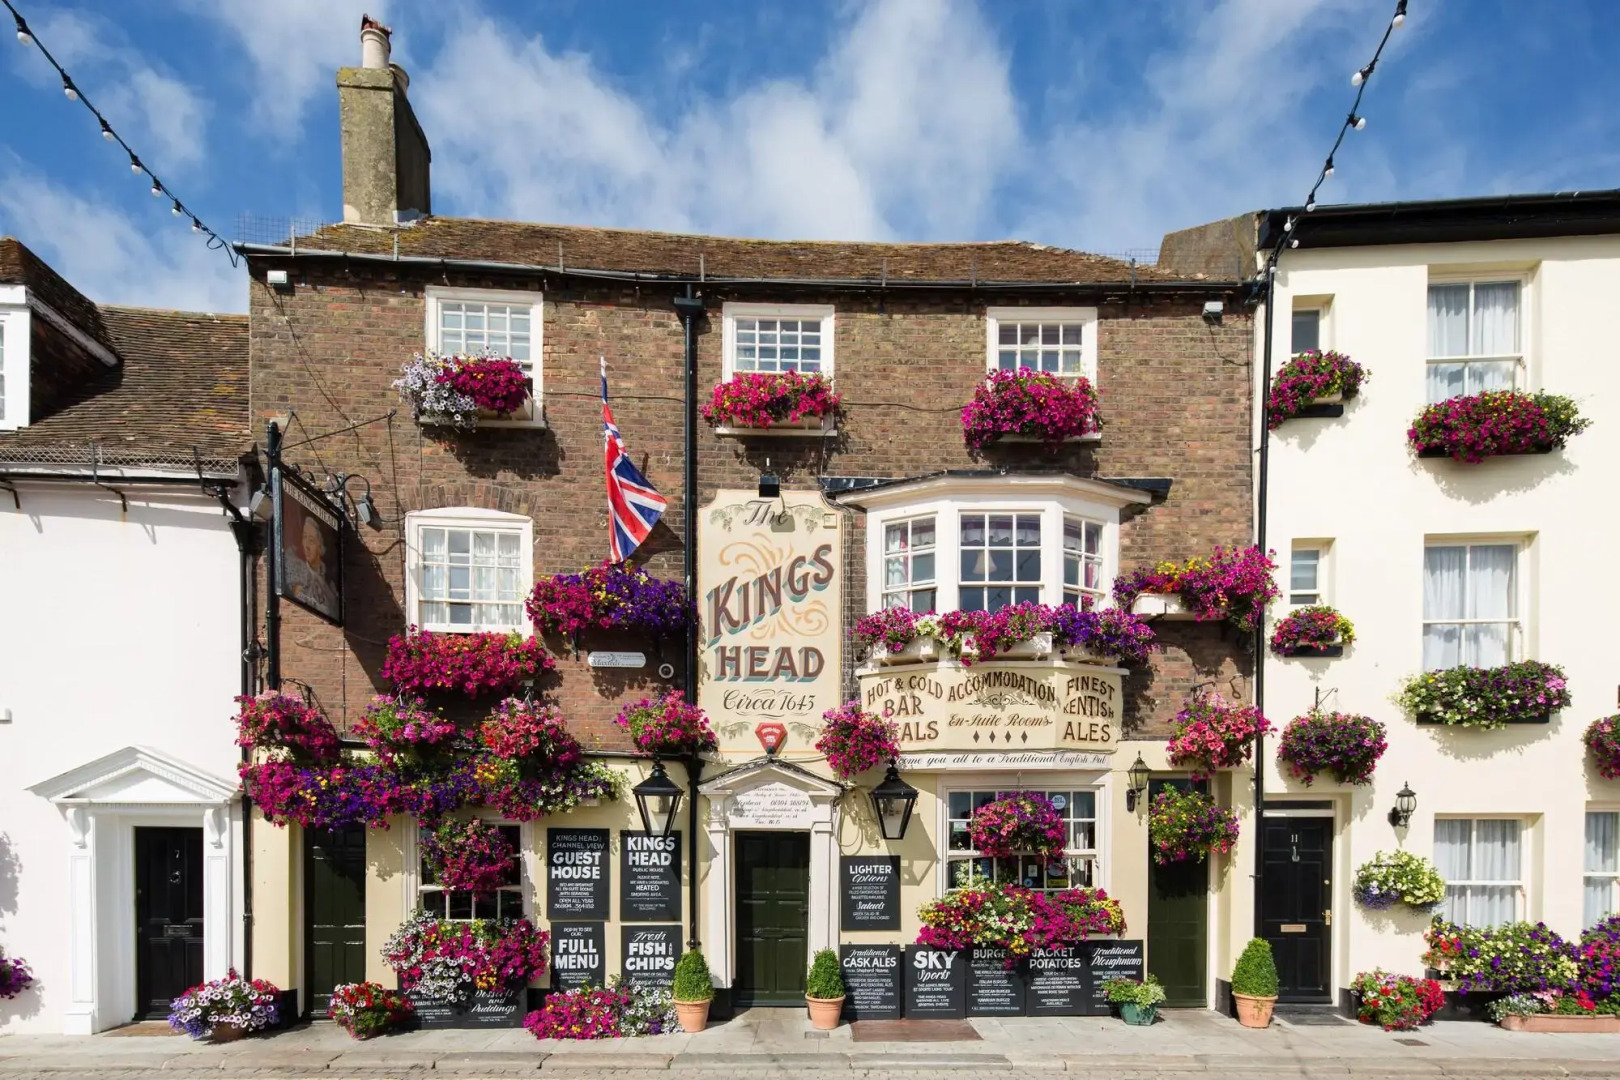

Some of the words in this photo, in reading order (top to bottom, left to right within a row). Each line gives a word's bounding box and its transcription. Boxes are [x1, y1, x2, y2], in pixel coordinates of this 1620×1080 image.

[743, 500, 789, 526] The
[706, 543, 835, 649] KINGS
[714, 645, 825, 682] HEAD
[867, 678, 892, 706] HOT
[894, 677, 904, 690] &
[909, 675, 943, 699] COLD
[947, 671, 1055, 702] ACCOMMODATION
[1066, 675, 1115, 700] FINEST
[723, 689, 775, 711] Circa
[884, 695, 925, 717] BAR
[1063, 695, 1115, 719] KENTISH
[1004, 712, 1053, 727] Rooms
[1063, 721, 1111, 743] ALES
[926, 756, 947, 767] you
[952, 754, 969, 764] all
[973, 754, 983, 764] to
[998, 752, 1057, 764] Traditional
[1059, 753, 1088, 766] English
[556, 834, 577, 842] KINGS
[627, 836, 676, 851] KINGS
[1291, 834, 1299, 843] 11
[174, 849, 180, 859] 7
[552, 851, 602, 866] GUEST
[628, 851, 672, 866] HEAD
[551, 865, 601, 879] HOUSE
[849, 865, 892, 875] LIGHTER
[851, 873, 888, 883] Options
[855, 900, 886, 910] Salads
[632, 931, 667, 943] Fresh
[558, 938, 597, 954] FULL
[628, 942, 666, 956] FISH
[849, 948, 890, 958] Traditional
[1031, 947, 1075, 958] JACKET
[1092, 946, 1138, 957] Traditional
[554, 954, 599, 969] MENU
[625, 956, 675, 970] CHIPS
[843, 957, 871, 968] CASK
[872, 956, 897, 968] ALES
[913, 950, 959, 969] SKY
[1029, 957, 1081, 969] POTATOES
[1091, 956, 1142, 969] Ploughmans
[917, 969, 951, 982] Sports
[470, 1003, 518, 1015] Puddings
